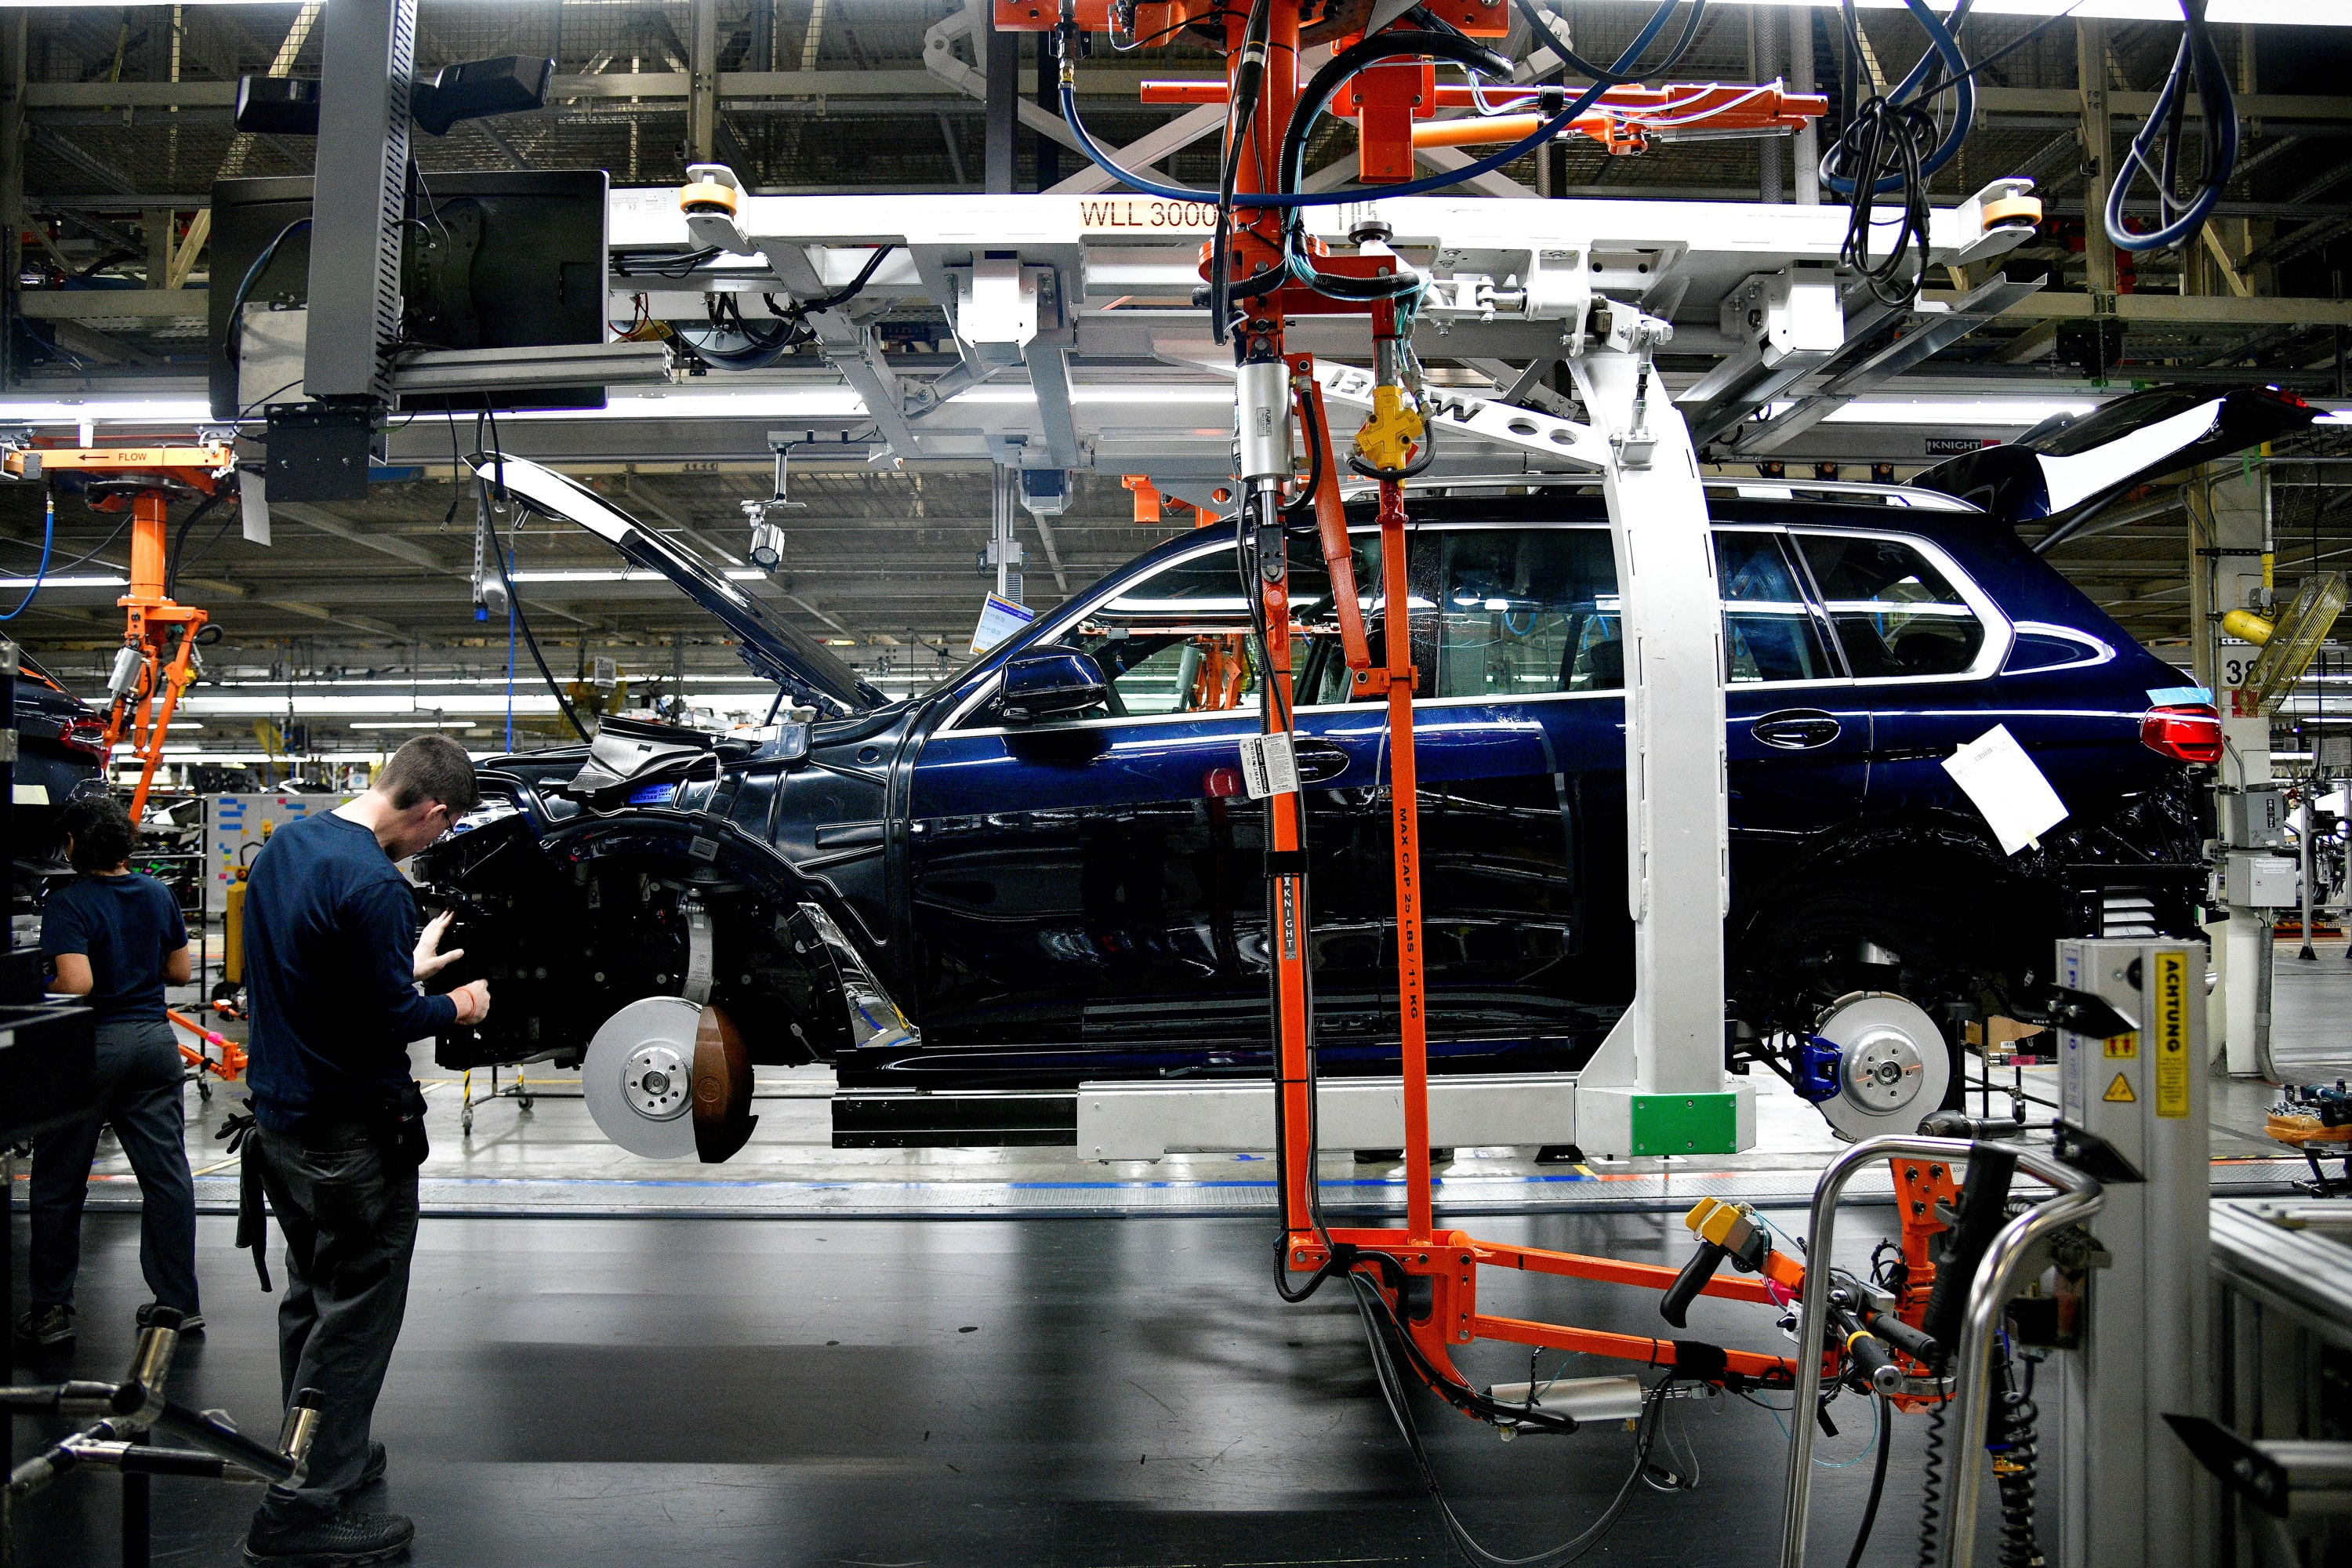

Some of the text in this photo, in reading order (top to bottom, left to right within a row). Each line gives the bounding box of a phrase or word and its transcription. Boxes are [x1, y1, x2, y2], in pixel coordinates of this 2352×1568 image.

[1080, 201, 1217, 227] WLL 3000
[1326, 368, 1486, 423] BW
[118, 452, 147, 461] FLOW
[1933, 441, 1980, 449] KNIGHT
[1399, 808, 1408, 845] MAX
[1404, 894, 1412, 913] 25
[1284, 889, 1293, 947] KNIGHT
[1409, 969, 1416, 986] 11
[1410, 995, 1418, 1018] KG
[2165, 960, 2180, 1052] ACHTUNG
